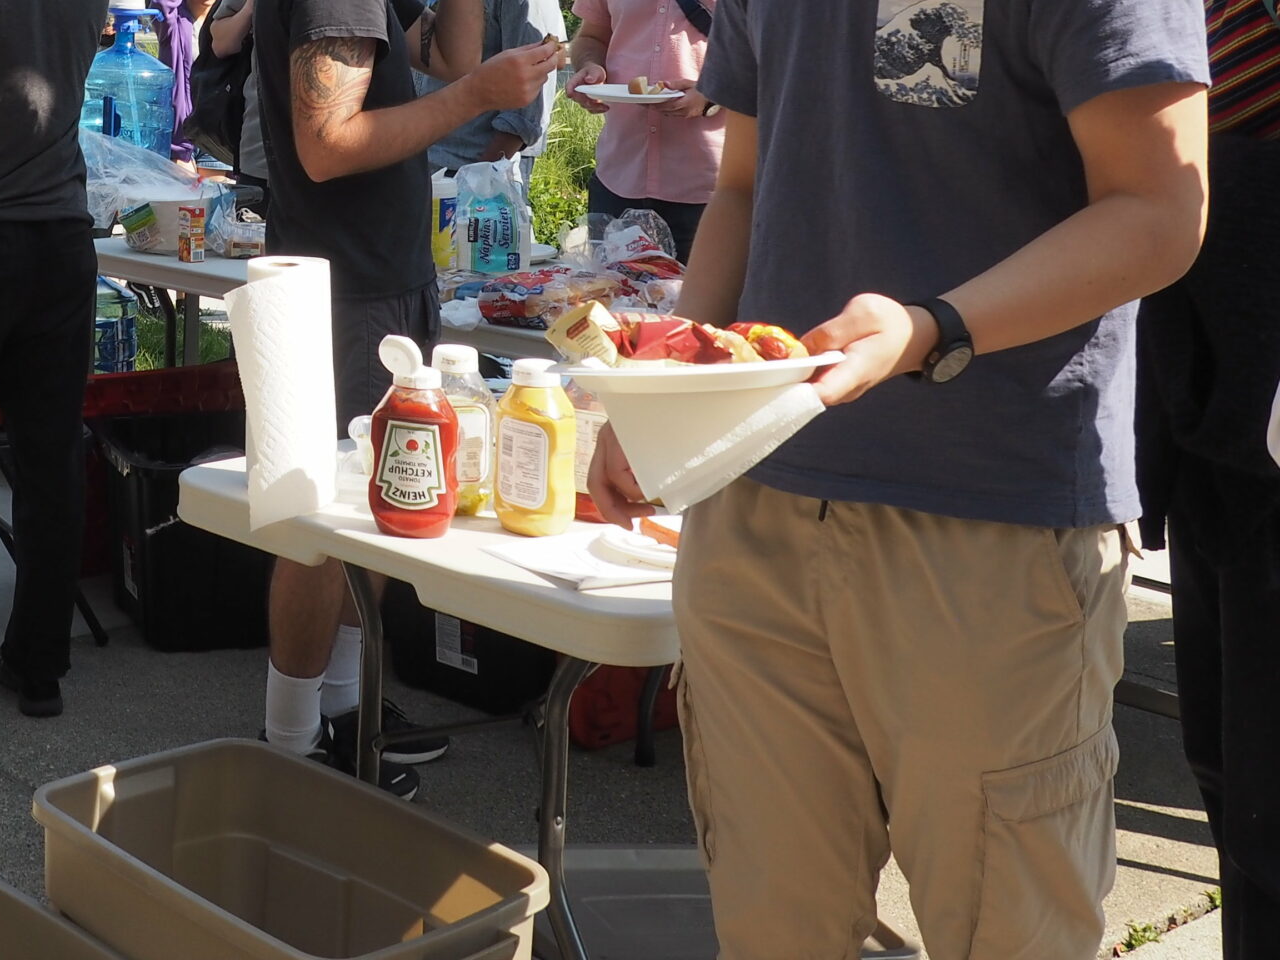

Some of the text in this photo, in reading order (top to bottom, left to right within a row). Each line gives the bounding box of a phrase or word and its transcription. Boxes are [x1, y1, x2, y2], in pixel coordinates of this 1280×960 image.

[479, 219, 492, 264] Napkins
[389, 466, 432, 478] KETCHUP
[392, 486, 426, 501] HEINZ
